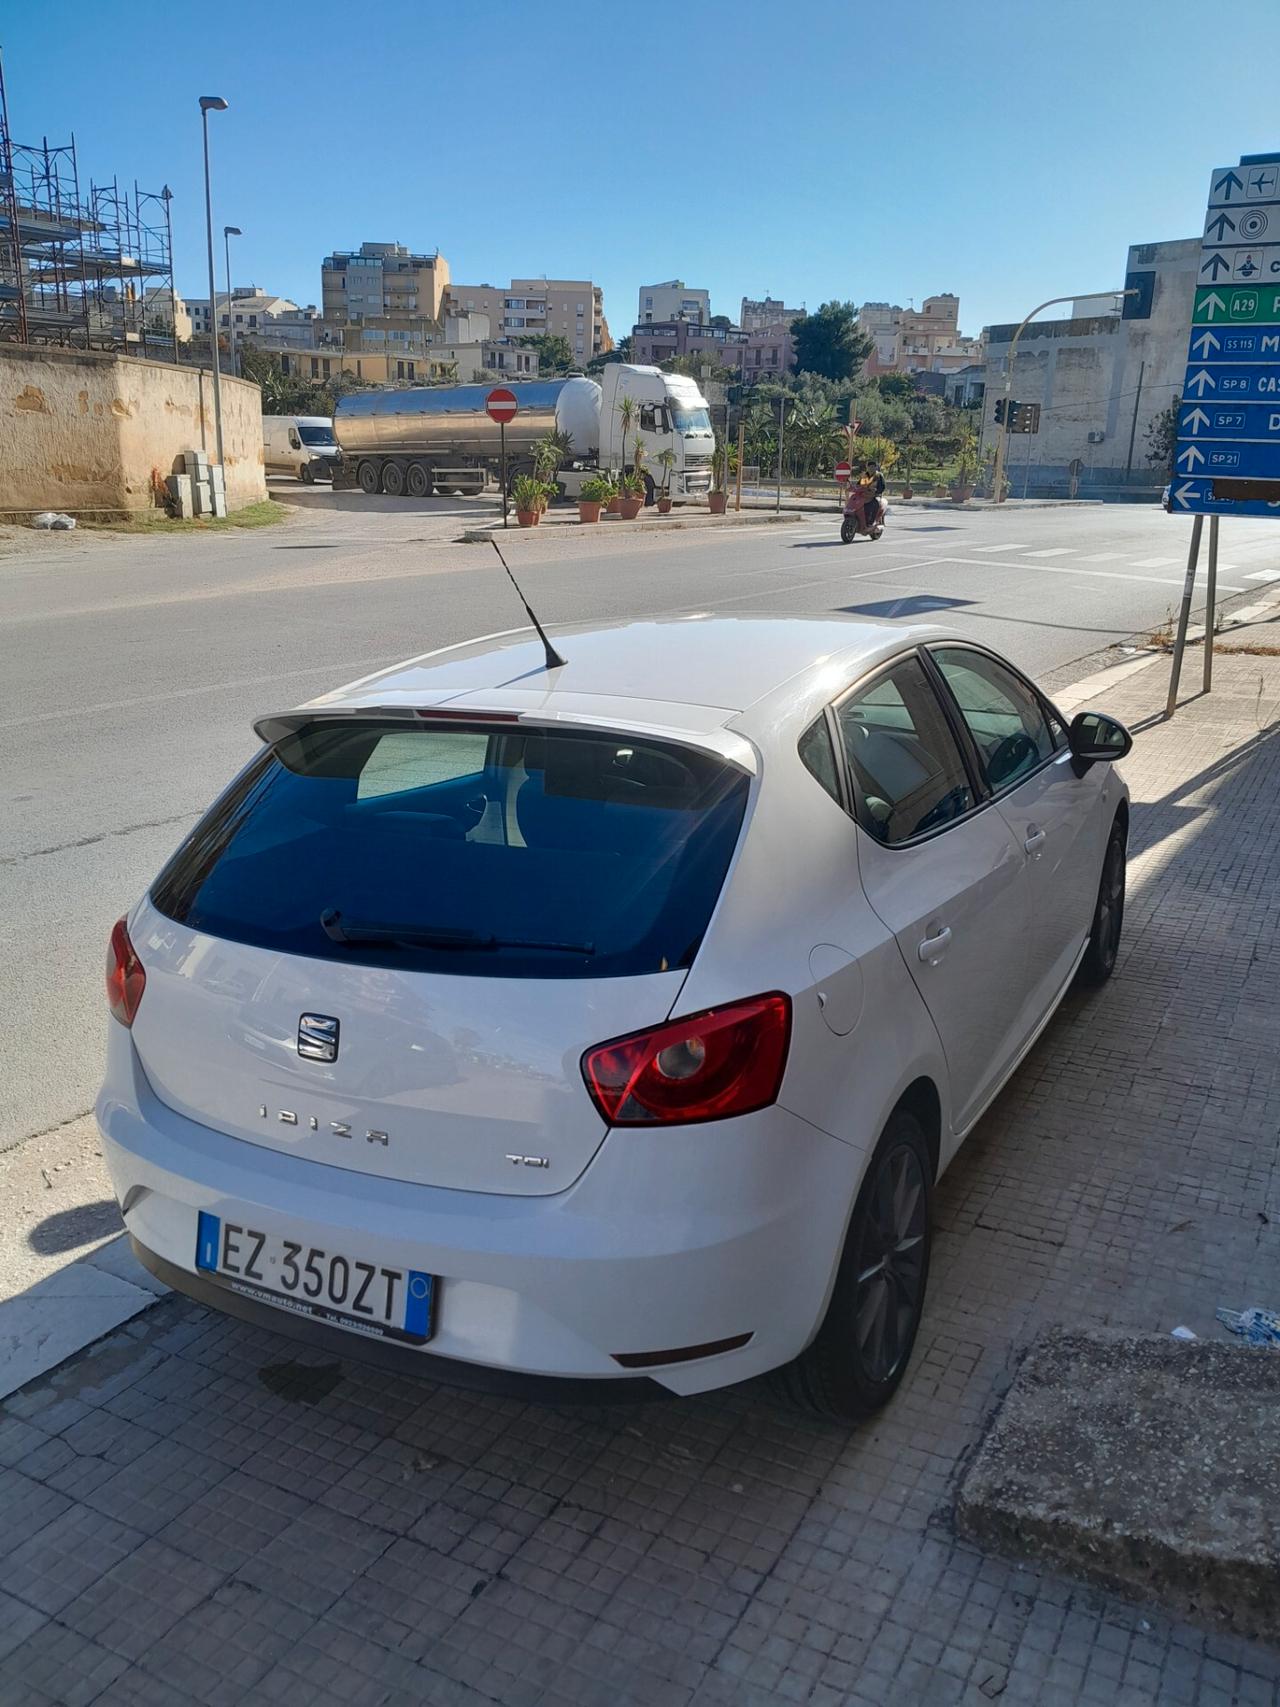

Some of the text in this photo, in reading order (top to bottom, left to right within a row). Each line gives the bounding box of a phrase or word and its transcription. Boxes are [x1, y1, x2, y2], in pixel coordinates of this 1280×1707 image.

[1233, 299, 1255, 312] A29
[1227, 340, 1238, 349] SS
[1240, 339, 1253, 349] 115
[1222, 379, 1238, 389] SP
[1239, 379, 1247, 389] 8
[1218, 416, 1233, 425] SP
[1235, 416, 1243, 425] 7
[1211, 455, 1238, 464] SP 21
[258, 1103, 390, 1147] IBIZA
[505, 1153, 551, 1169] TDI
[222, 1222, 402, 1321] EZ 350ZT
